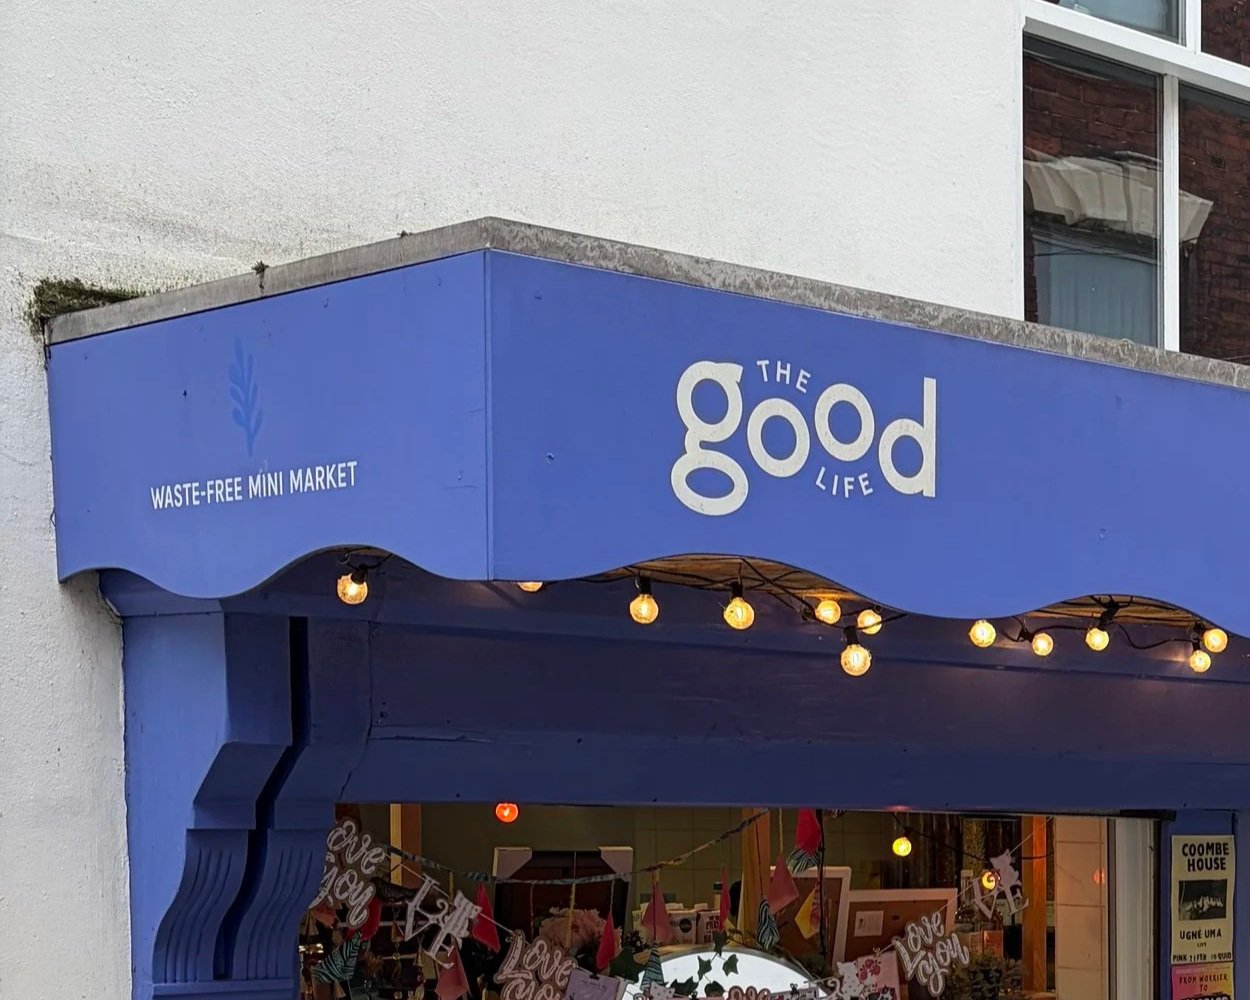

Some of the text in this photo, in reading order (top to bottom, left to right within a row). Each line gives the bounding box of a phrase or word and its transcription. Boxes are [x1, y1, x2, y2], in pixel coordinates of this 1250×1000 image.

[757, 360, 811, 394] THE
[671, 360, 937, 516] good
[150, 461, 358, 510] WASTE-FREE MINI MARKET
[815, 466, 874, 498] LIFE
[1181, 842, 1230, 857] COOMBE
[1187, 857, 1227, 872] HOUSE
[1204, 928, 1223, 939] UMA
[1179, 975, 1197, 985] FROM
[1200, 984, 1208, 992] TO
